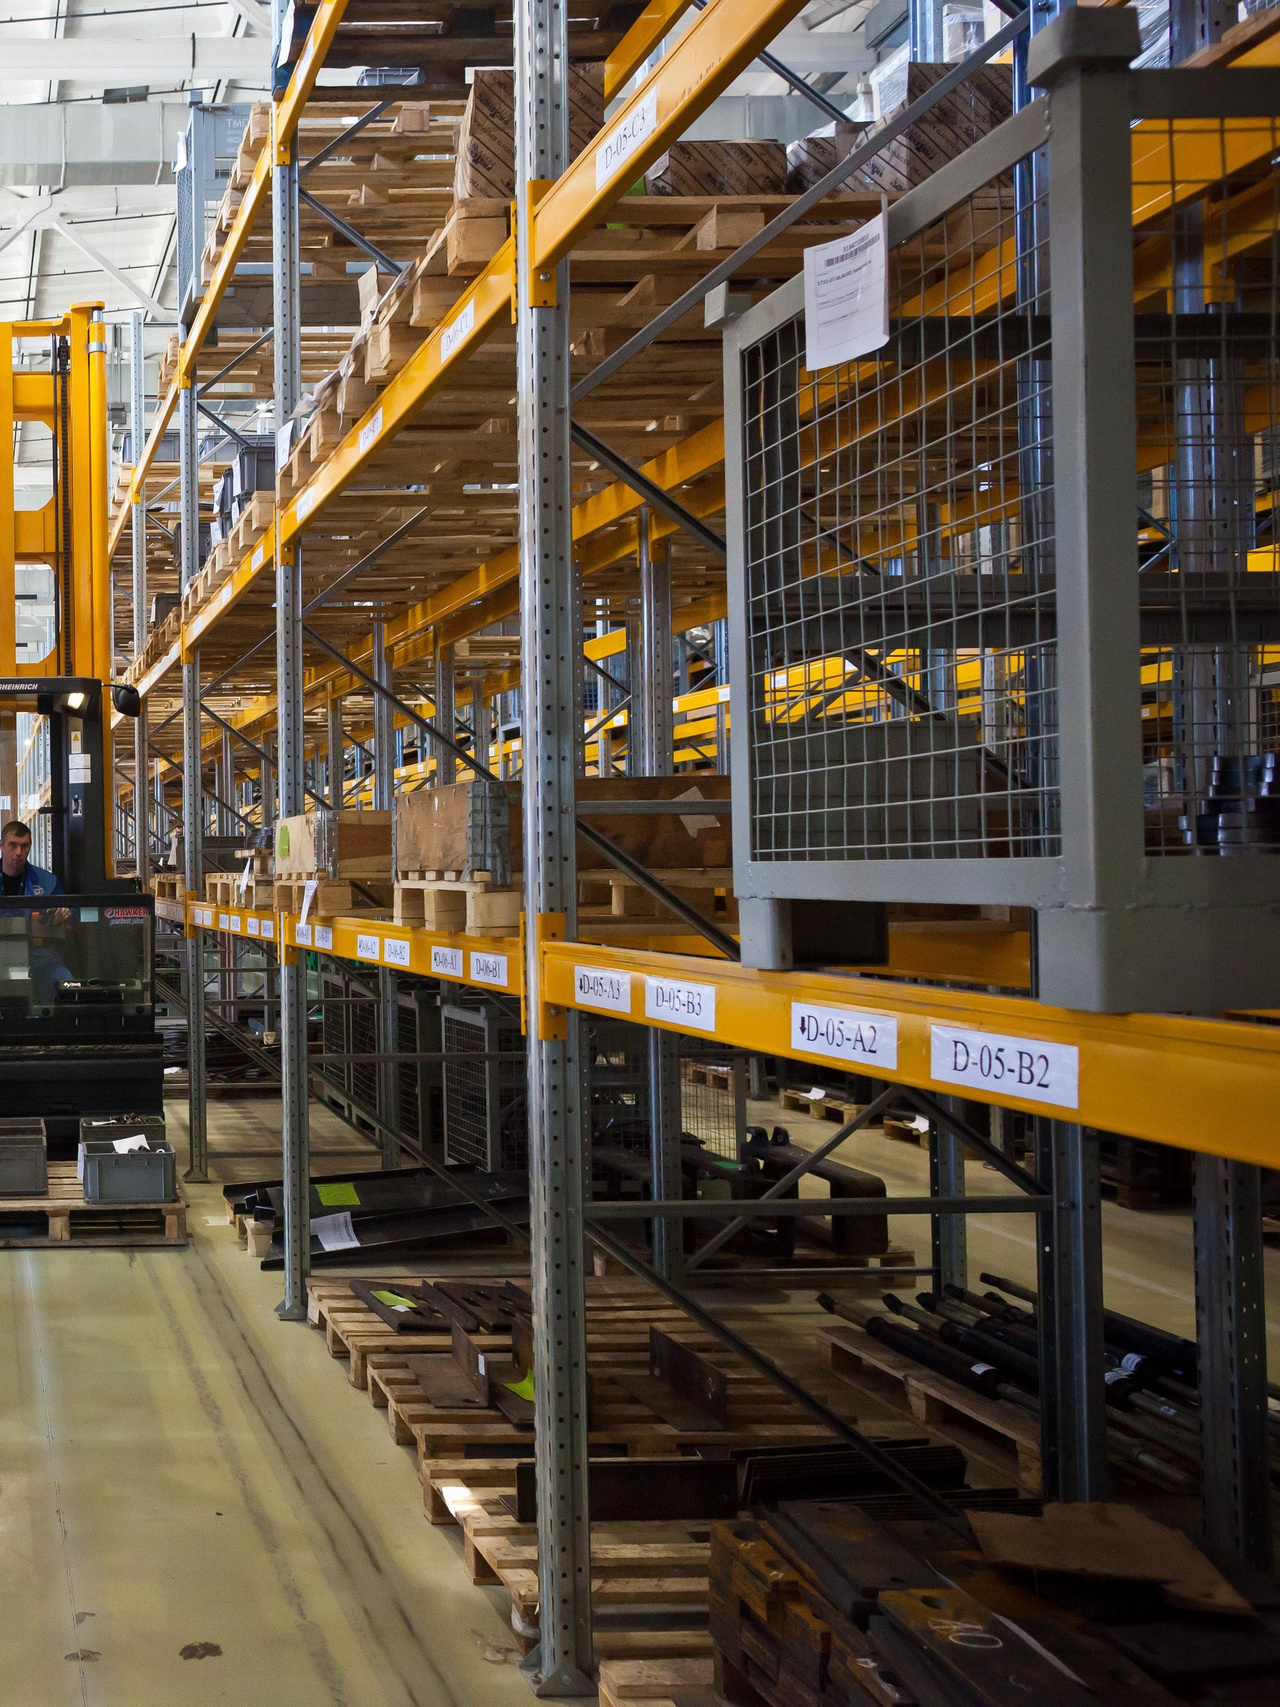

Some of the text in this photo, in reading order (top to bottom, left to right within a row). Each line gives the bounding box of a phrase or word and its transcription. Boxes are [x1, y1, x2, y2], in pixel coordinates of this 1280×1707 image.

[605, 107, 645, 169] D-05-C3
[114, 908, 148, 917] HAWKER
[436, 952, 457, 971] D-06-A1
[476, 958, 501, 979] D-06-B1
[582, 974, 621, 1000] D-05-A3
[655, 986, 702, 1016] D-05-B3
[806, 1014, 878, 1055] D-05-A2
[952, 1040, 1050, 1089] D-05-B2
